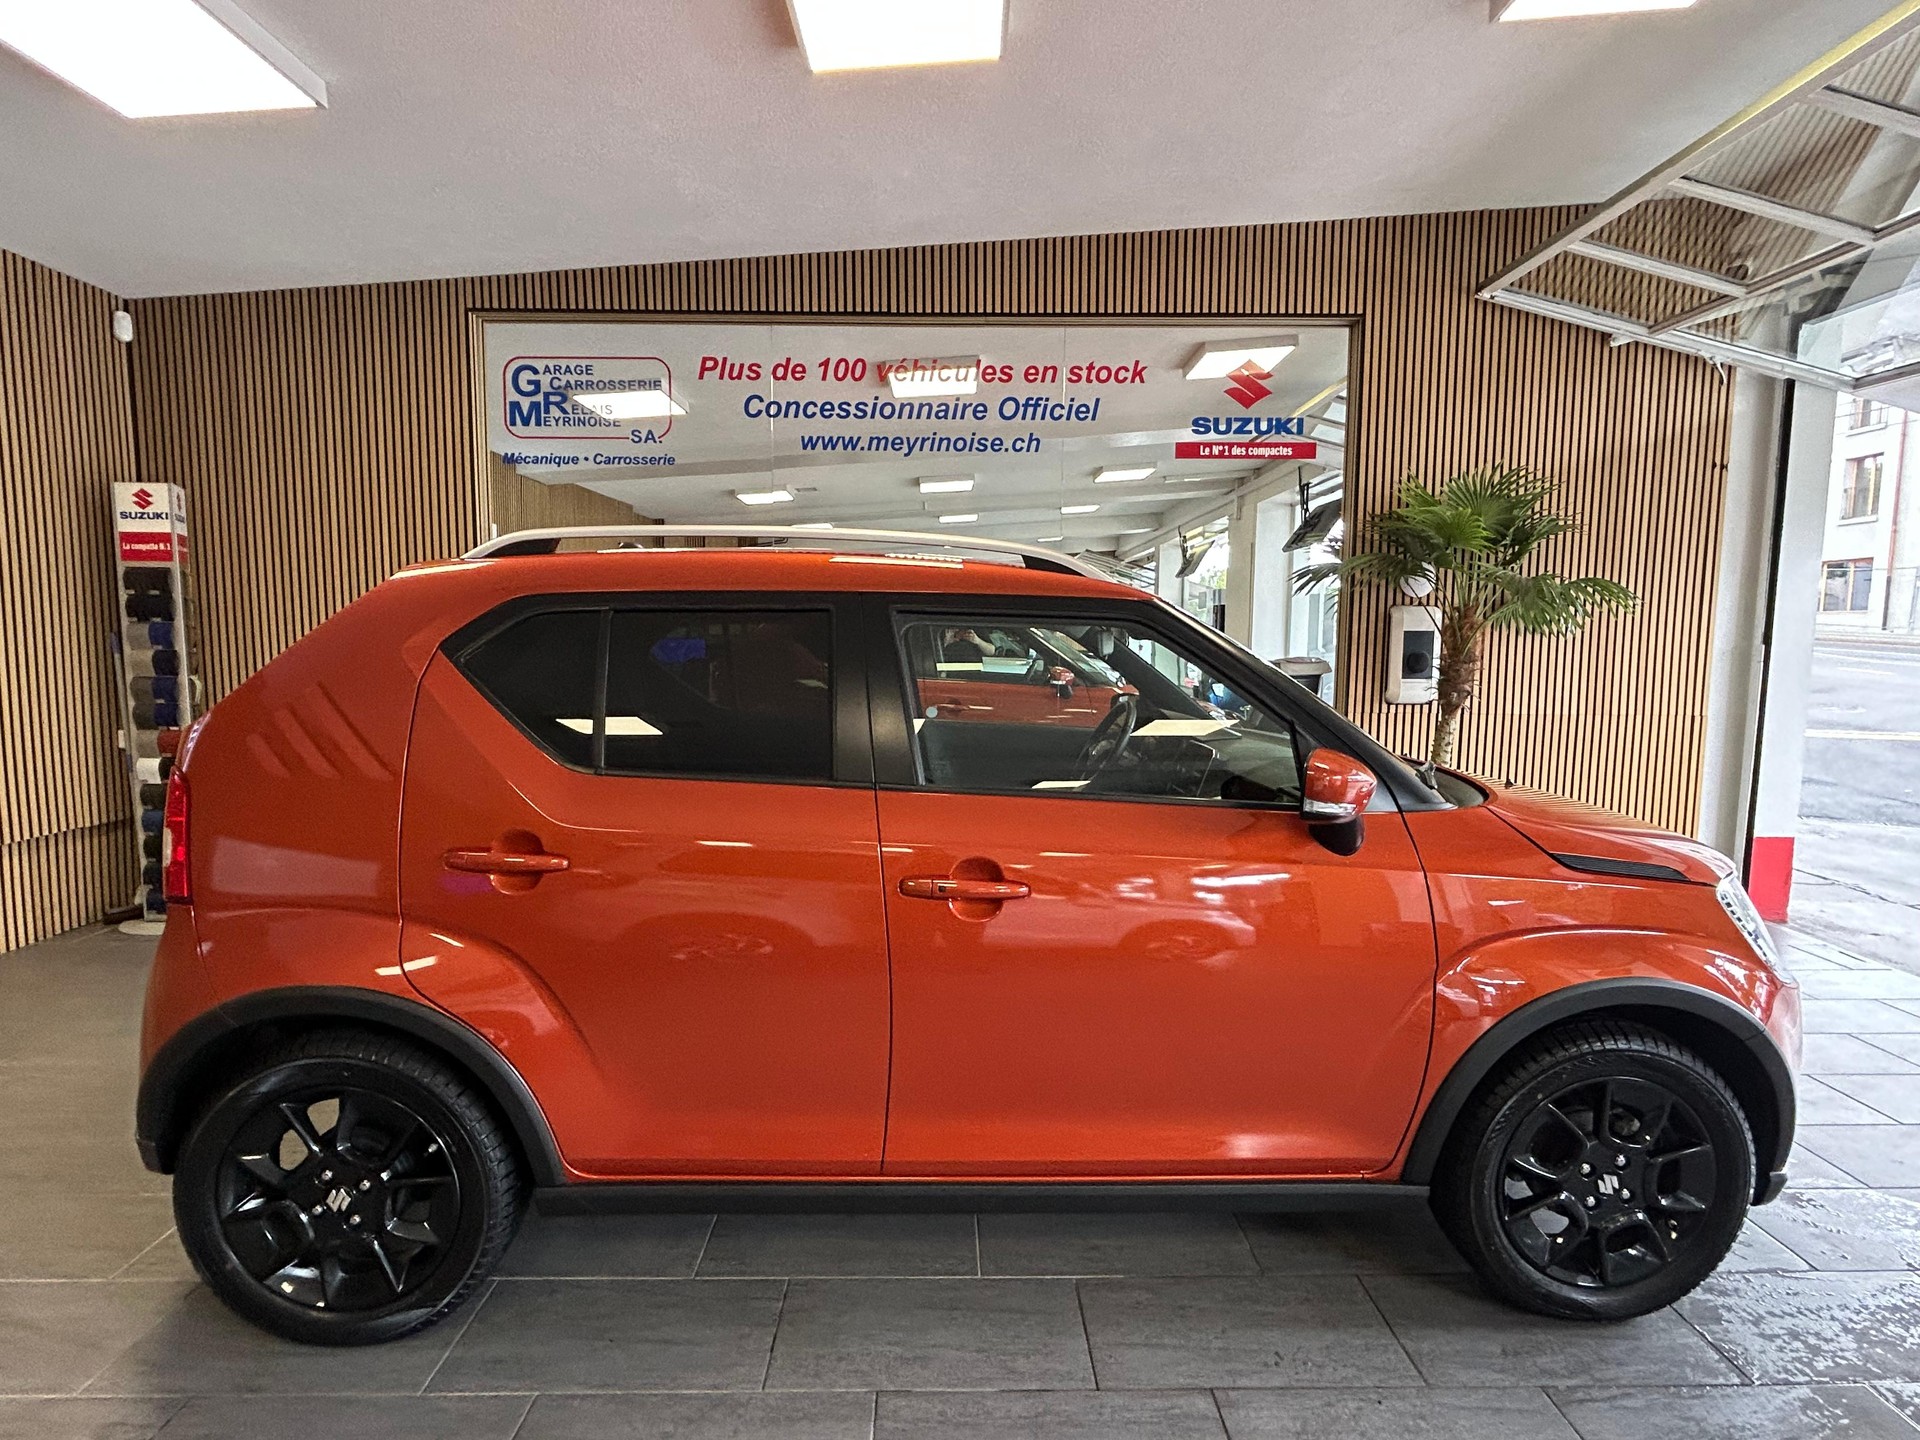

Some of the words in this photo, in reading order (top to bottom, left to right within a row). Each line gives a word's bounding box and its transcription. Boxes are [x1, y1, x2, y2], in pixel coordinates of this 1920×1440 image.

[511, 364, 594, 397] GARAGE
[698, 356, 762, 381] Plus
[772, 357, 807, 381] de
[818, 357, 867, 382] 100
[876, 358, 1014, 383] véhicules
[1023, 364, 1058, 383] en
[1066, 360, 1148, 384] stock
[549, 376, 662, 391] CARROSSERIE
[508, 400, 621, 427] MEYRINOISE
[743, 394, 988, 421] Concessionnaire
[998, 396, 1101, 421] Officiel
[1191, 416, 1304, 435] SUZUKI
[801, 432, 1041, 458] www.meyrinoise.ch
[1200, 445, 1210, 456] Le
[1231, 445, 1246, 456] des
[1248, 445, 1293, 457] compactes
[502, 452, 580, 466] Mécanique
[593, 453, 676, 466] Carrosserie
[120, 511, 168, 520] SUZUKI
